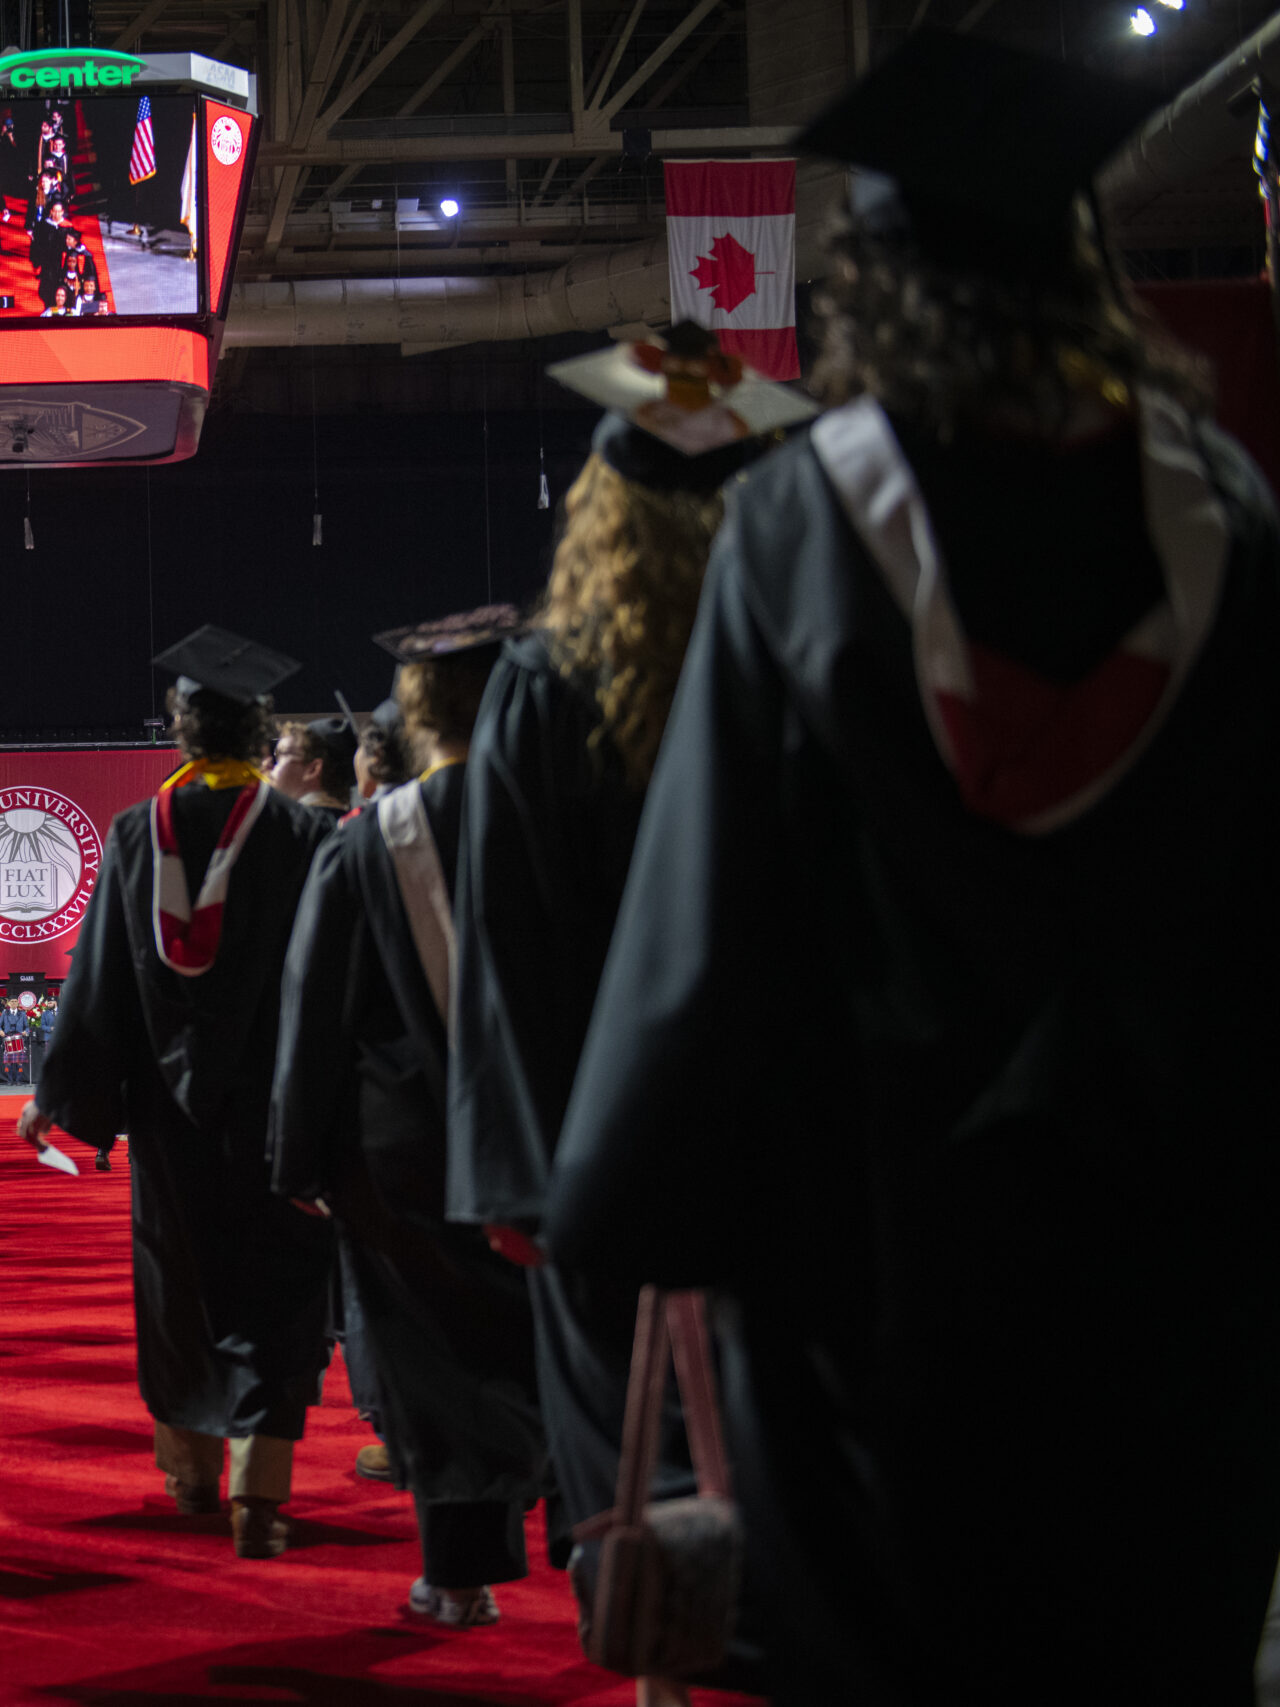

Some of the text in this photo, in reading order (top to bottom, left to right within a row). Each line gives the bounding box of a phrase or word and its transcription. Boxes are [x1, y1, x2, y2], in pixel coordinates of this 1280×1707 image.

[10, 60, 141, 89] center
[4, 868, 48, 882] FIAT
[6, 885, 46, 898] LUX
